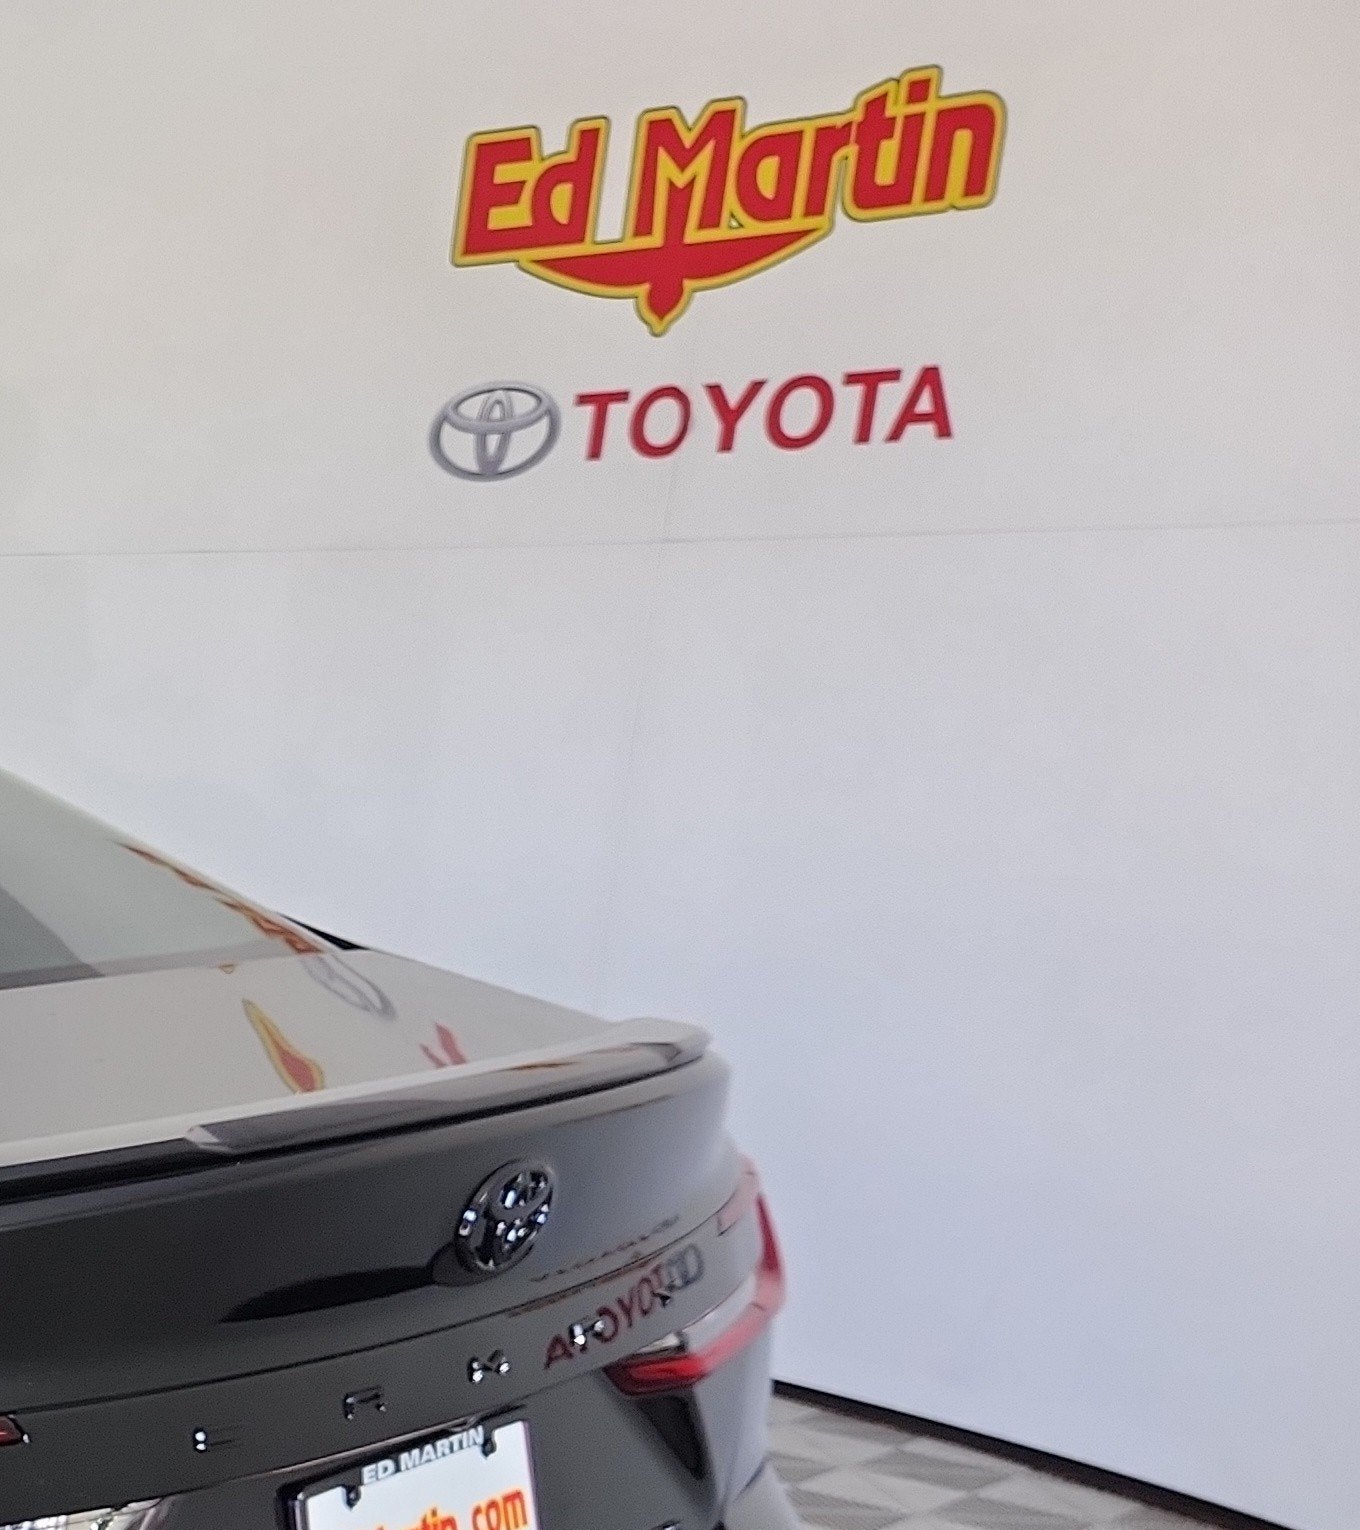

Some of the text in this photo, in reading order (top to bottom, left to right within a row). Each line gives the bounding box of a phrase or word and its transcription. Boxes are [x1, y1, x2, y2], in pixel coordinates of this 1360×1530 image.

[453, 64, 1007, 267] Ed Martin
[574, 365, 954, 461] TOYOTA
[361, 1426, 485, 1486] ED MARTIN
